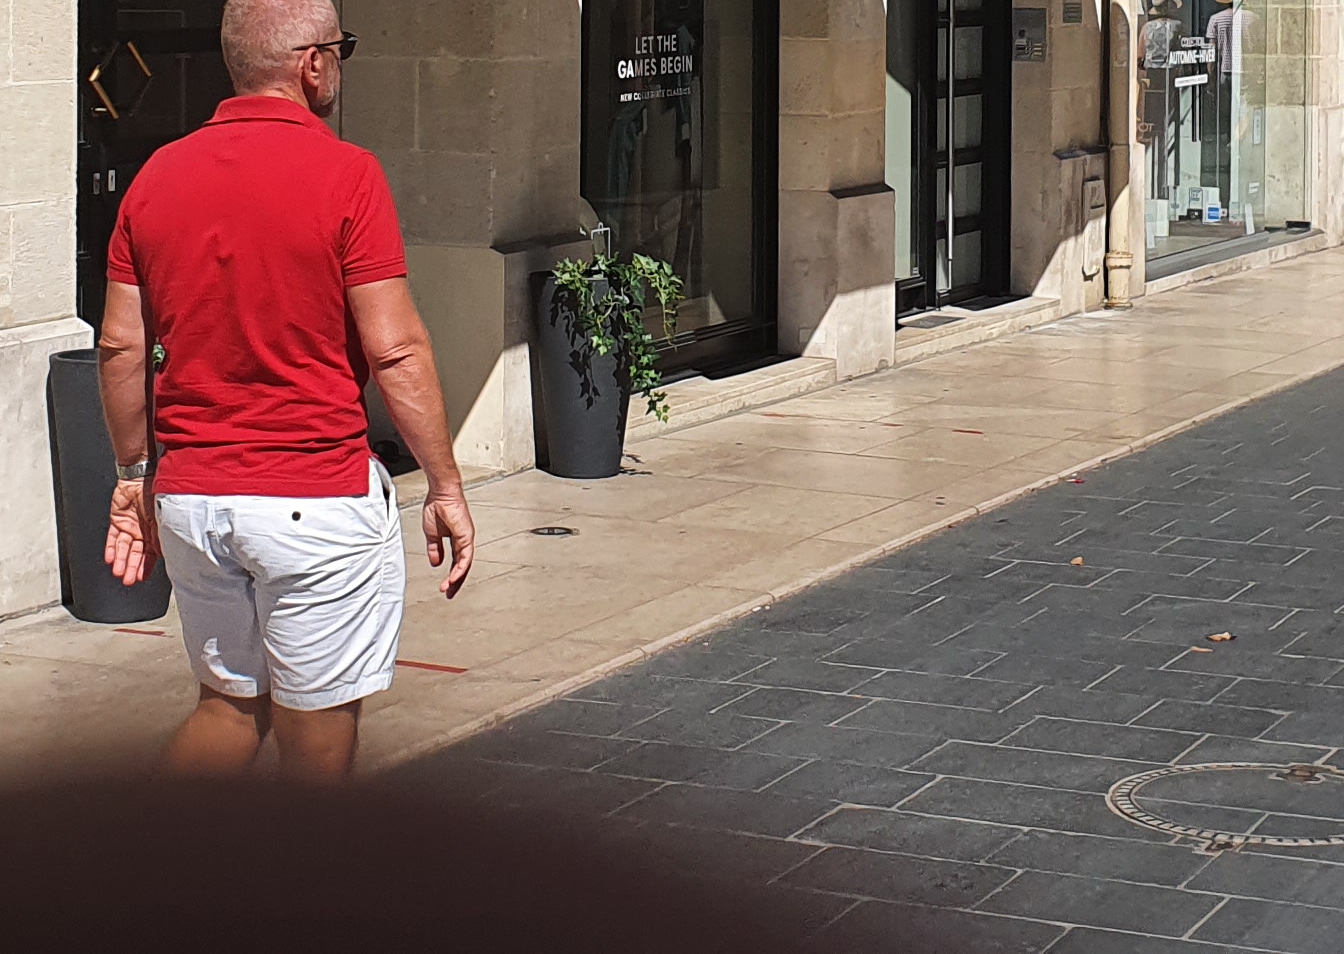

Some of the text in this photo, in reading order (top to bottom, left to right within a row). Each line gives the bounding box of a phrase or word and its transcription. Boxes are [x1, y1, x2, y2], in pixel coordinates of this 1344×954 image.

[635, 34, 678, 55] LET THE
[617, 54, 693, 79] GAMES BEGIN
